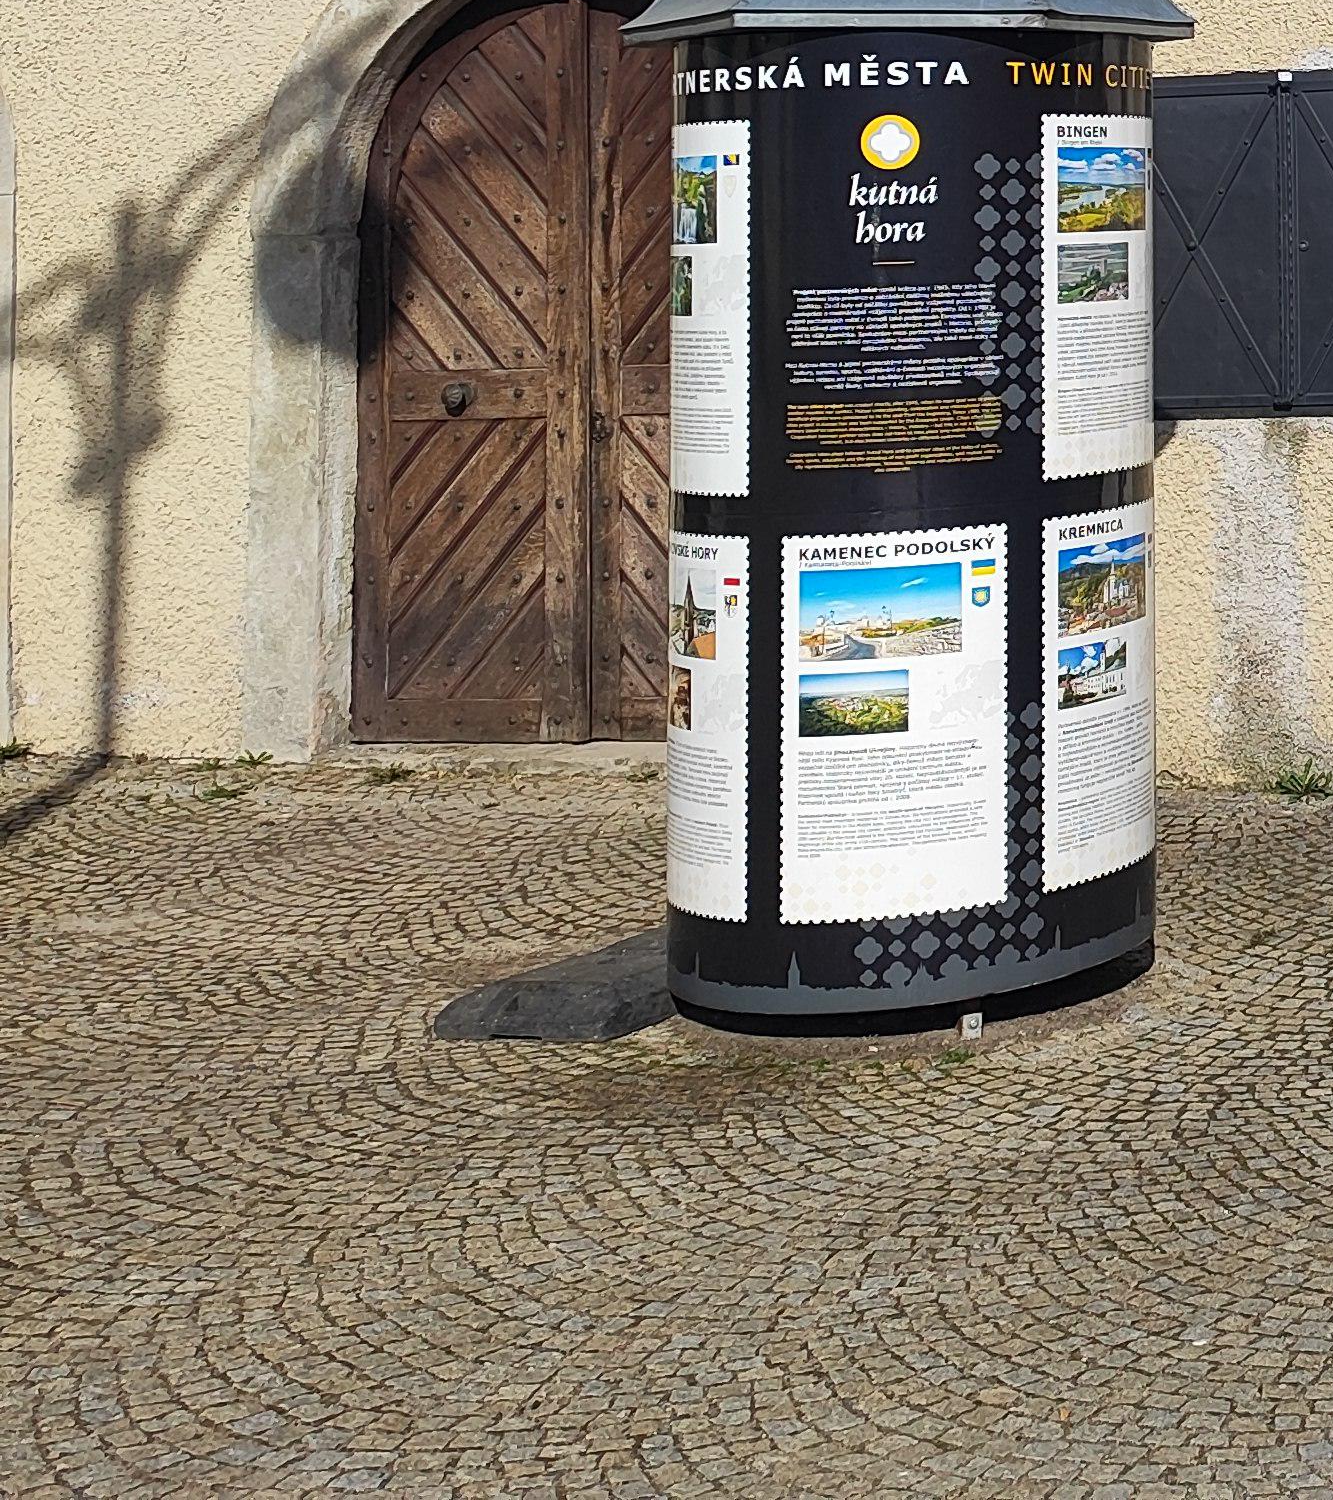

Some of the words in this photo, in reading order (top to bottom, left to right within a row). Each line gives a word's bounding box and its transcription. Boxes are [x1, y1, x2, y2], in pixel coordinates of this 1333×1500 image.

[823, 54, 970, 87] MĚSTA
[1005, 61, 1093, 87] TWIN
[1056, 125, 1108, 138] BINGEN
[848, 172, 939, 207] kutná
[855, 210, 927, 245] hora
[1058, 519, 1124, 541] KREMNICA
[691, 546, 719, 560] HORY
[798, 544, 888, 562] KAMENEC
[893, 532, 996, 558] PODOLSKÝ
